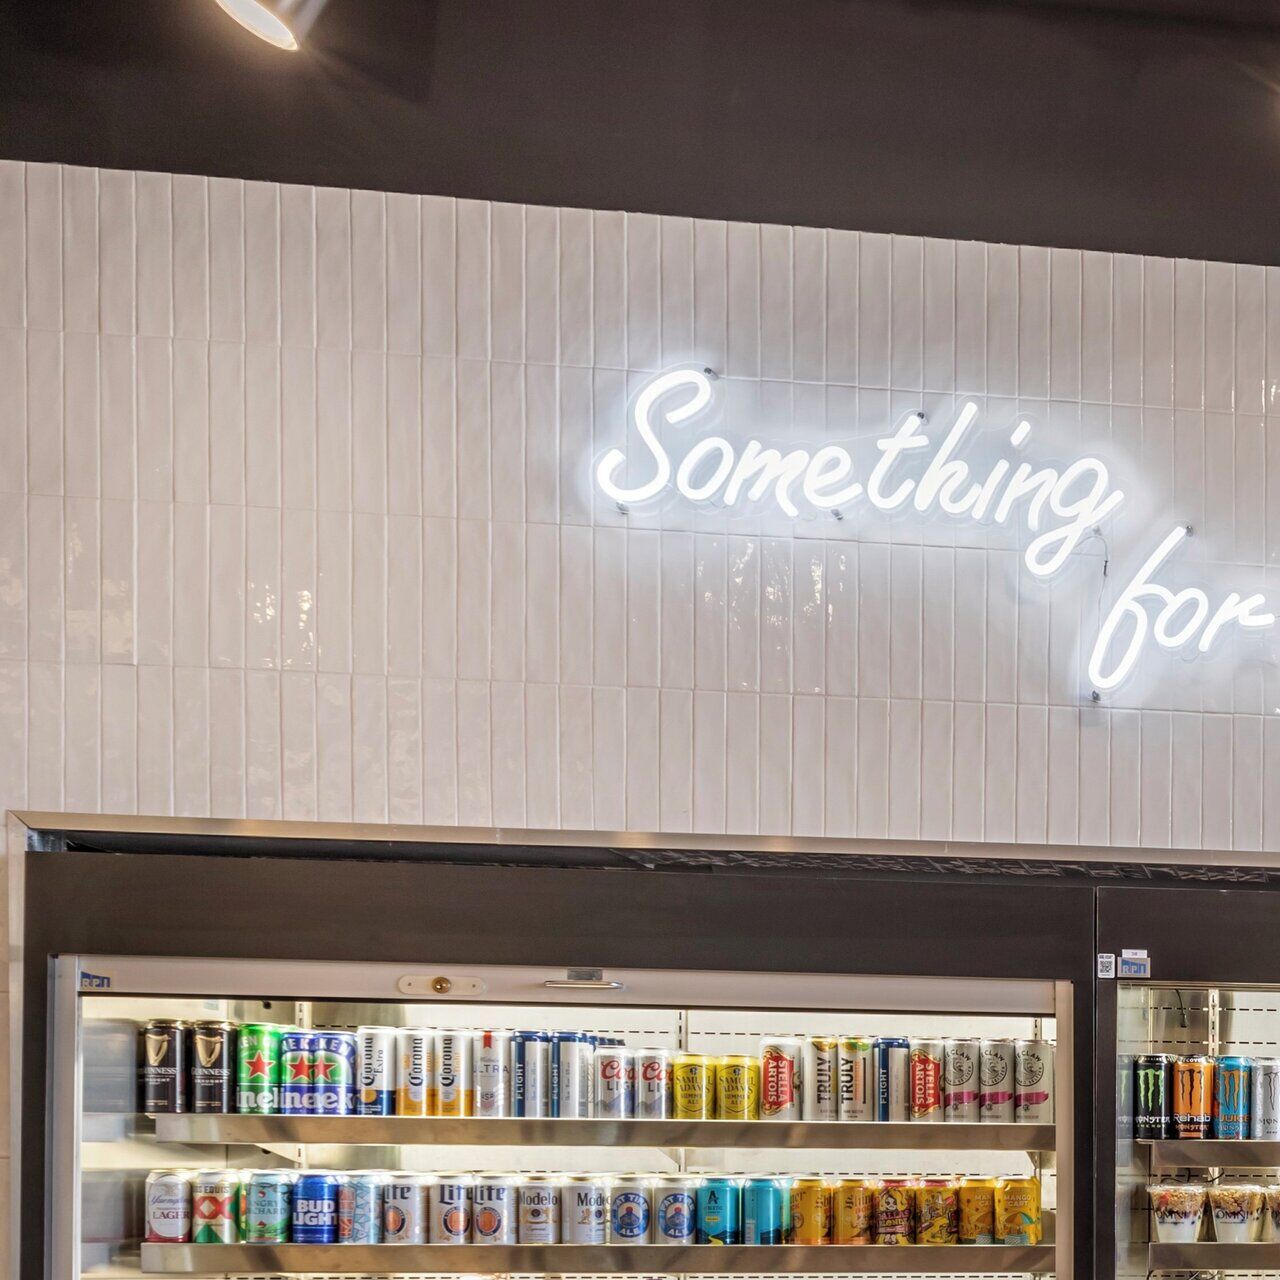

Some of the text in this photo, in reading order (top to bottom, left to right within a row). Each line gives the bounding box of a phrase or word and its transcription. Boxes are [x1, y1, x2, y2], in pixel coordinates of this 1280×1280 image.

[598, 368, 1124, 578] Something
[1087, 526, 1276, 693] for
[409, 1037, 423, 1087] Corona
[440, 1037, 455, 1087] Corona
[768, 1059, 777, 1102] ARTOIS
[778, 1060, 788, 1102] STELLA
[817, 1058, 831, 1104] TRULY
[841, 1058, 854, 1104] TRULY
[916, 1062, 924, 1104] ARTOIS
[880, 1068, 888, 1104] FLIGHT
[926, 1063, 935, 1104] STELLA
[1174, 1113, 1211, 1123] Rehab
[152, 1211, 191, 1220] LAGER
[292, 1212, 339, 1226] LIGHT
[296, 1199, 335, 1213] BUD
